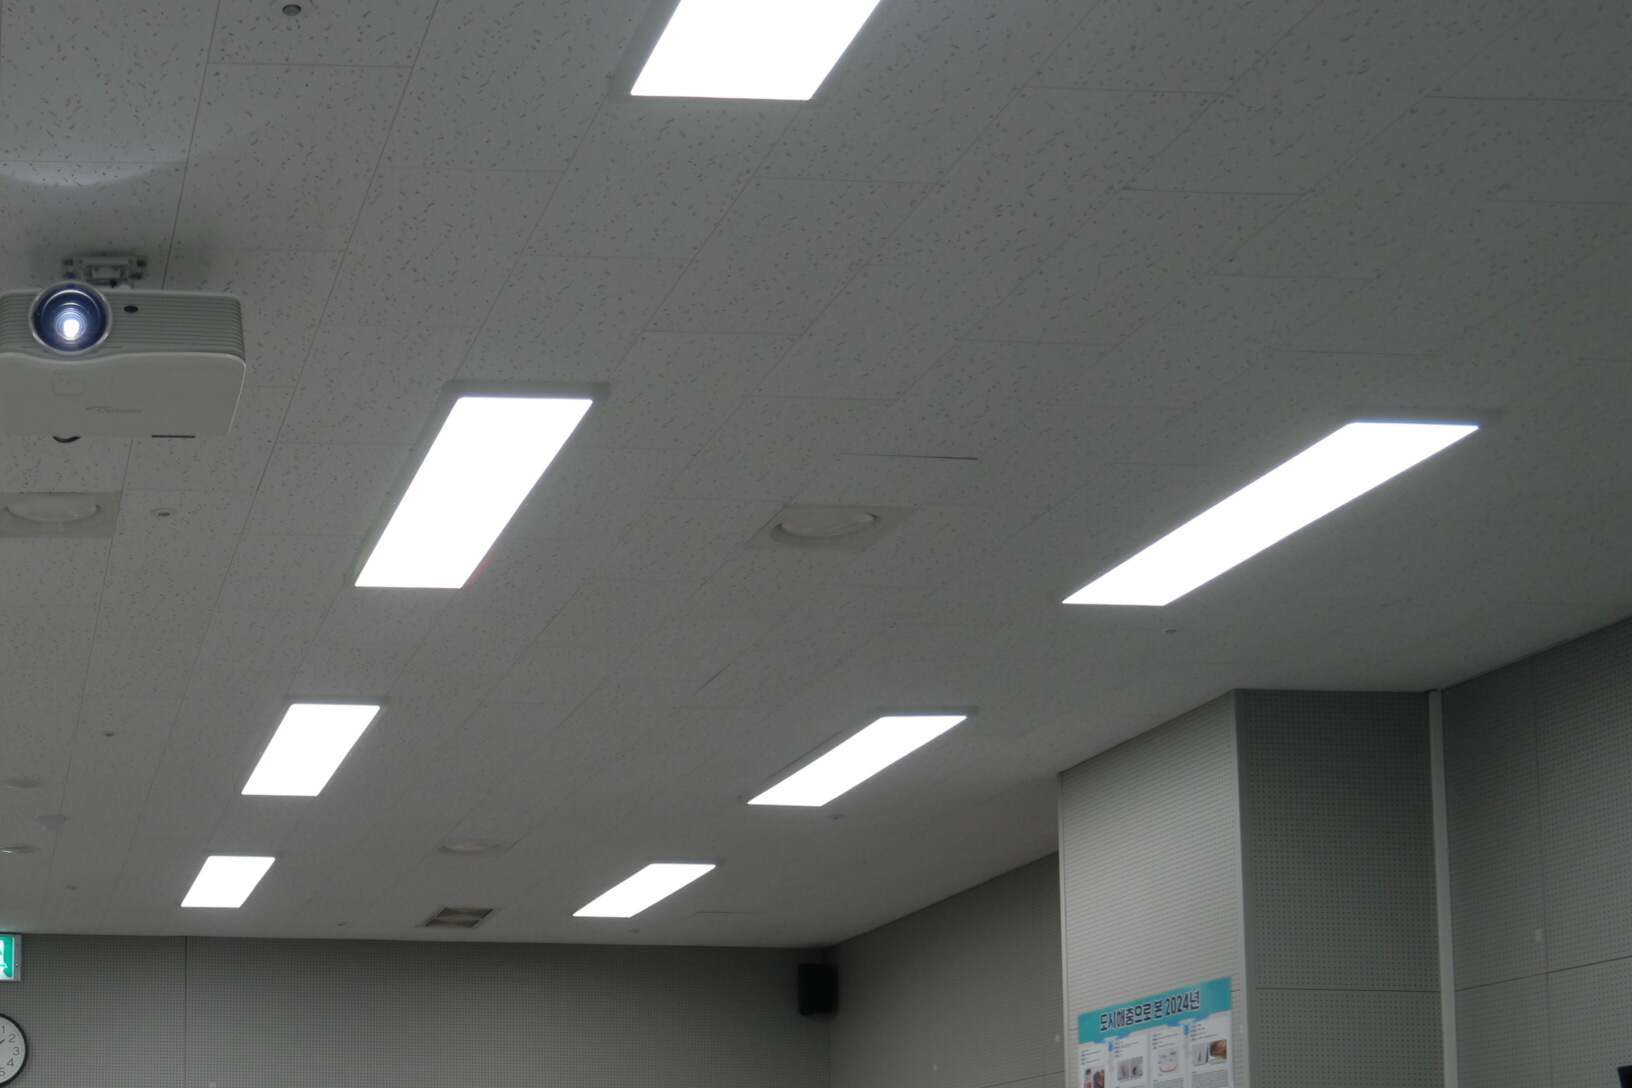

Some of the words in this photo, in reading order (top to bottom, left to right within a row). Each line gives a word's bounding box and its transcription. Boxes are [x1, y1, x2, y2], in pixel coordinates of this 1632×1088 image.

[96, 406, 142, 415] Optoma
[1100, 1001, 1152, 1032] 도시해충으로
[1153, 998, 1163, 1019] 본
[1164, 989, 1201, 1016] 2024년
[1, 1025, 5, 1034] 1
[8, 1033, 16, 1043] 2
[12, 1046, 20, 1055] 3
[6, 1057, 14, 1067] 4
